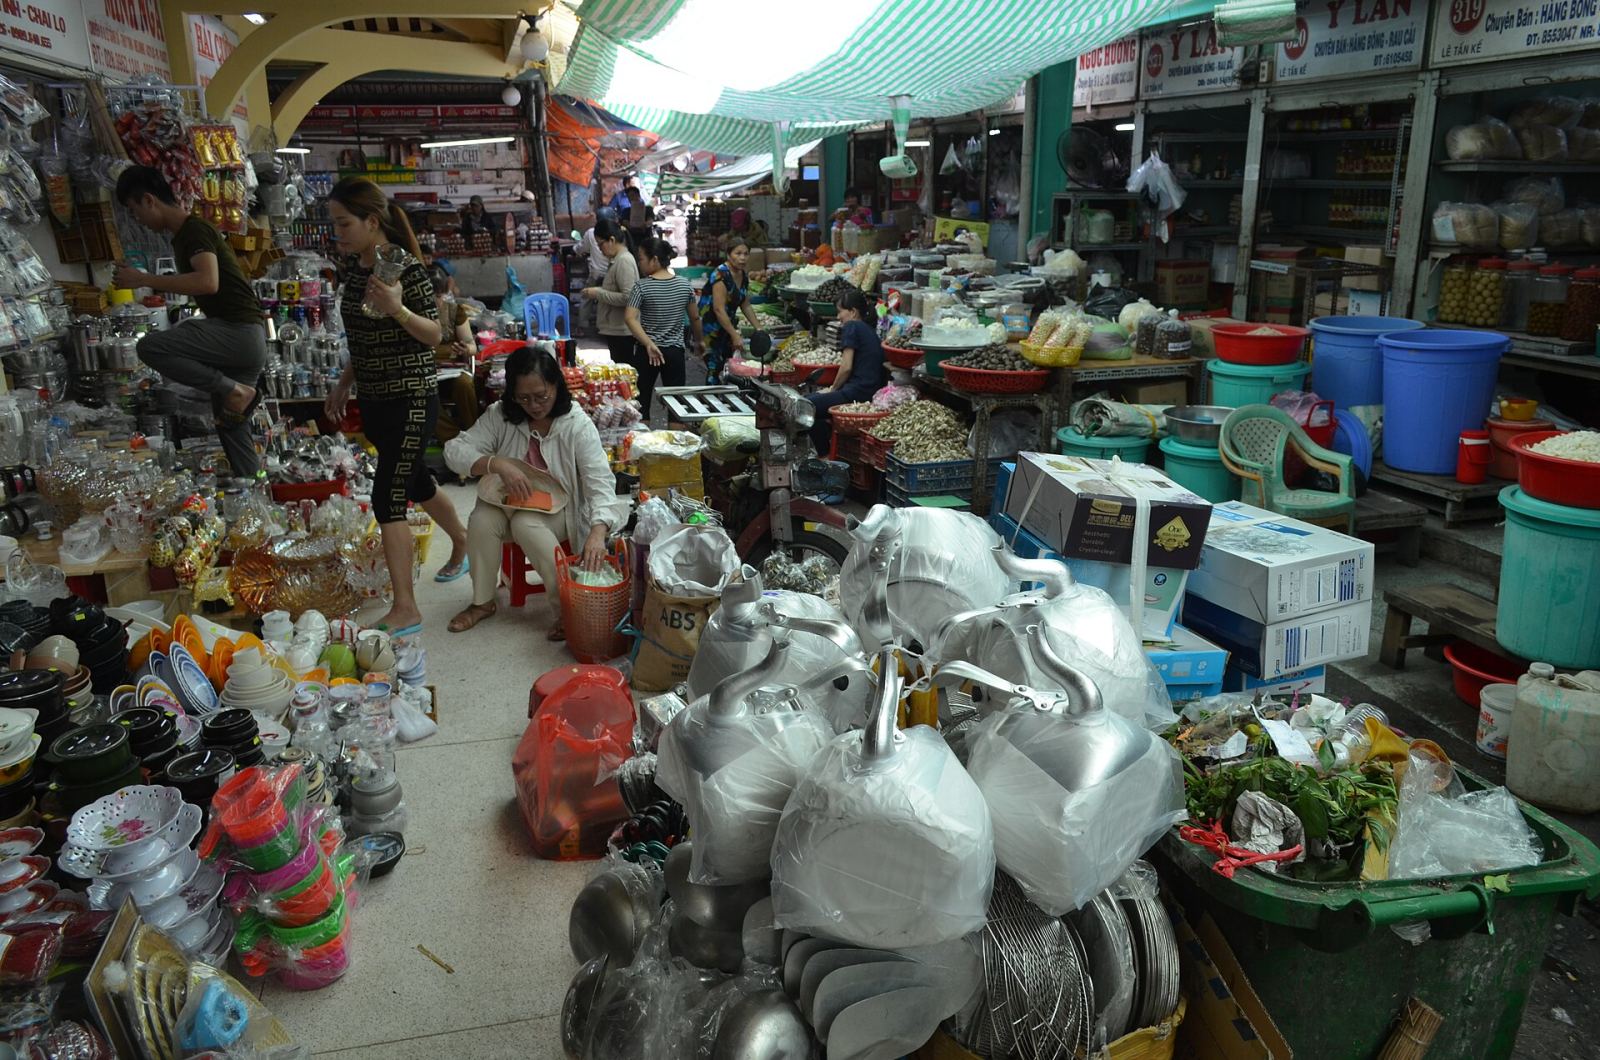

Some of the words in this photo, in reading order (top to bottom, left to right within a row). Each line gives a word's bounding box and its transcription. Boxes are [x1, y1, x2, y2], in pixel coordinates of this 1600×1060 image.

[27, 5, 52, 29] CHAI
[1453, 0, 1482, 23] 319
[1485, 11, 1514, 34] Chuyên
[1516, 8, 1534, 27] Bán
[1541, 26, 1577, 44] 8553047
[660, 607, 696, 632] ABS
